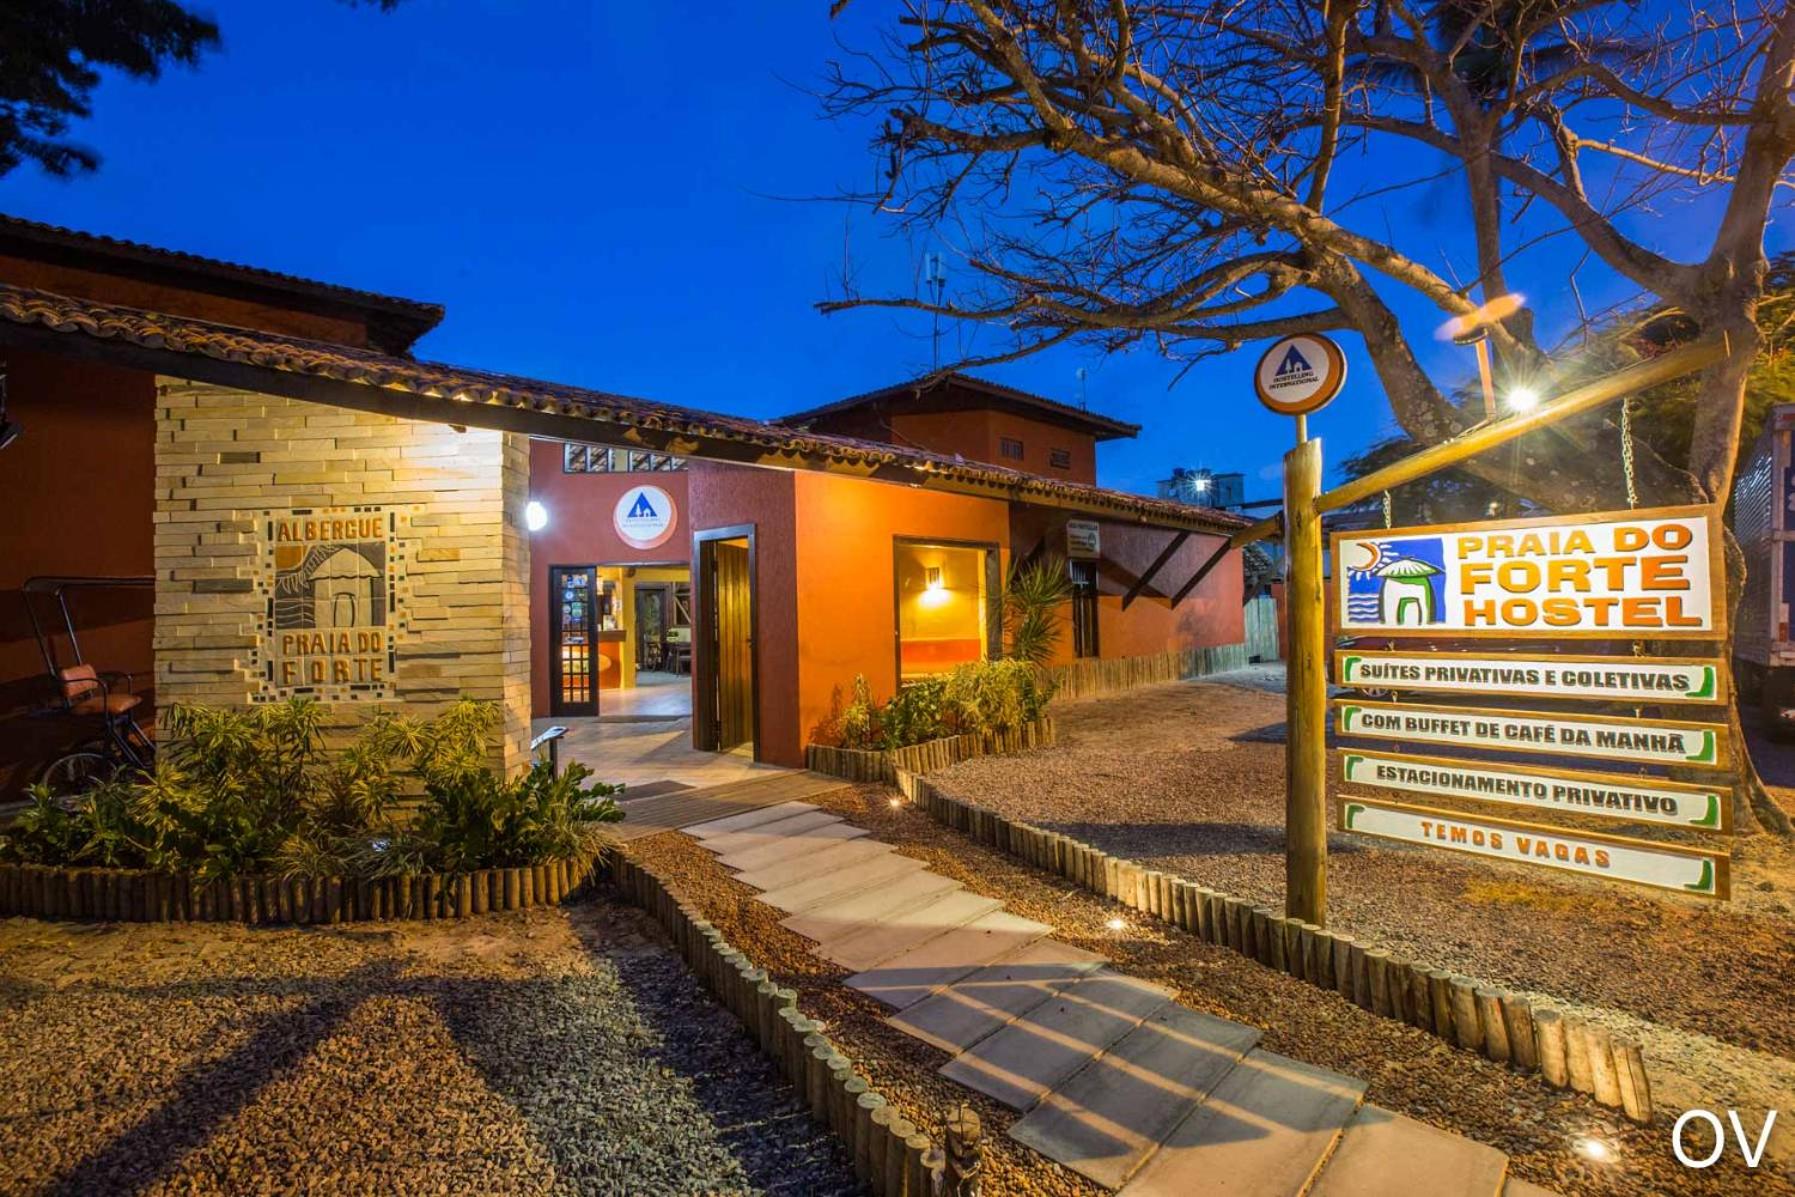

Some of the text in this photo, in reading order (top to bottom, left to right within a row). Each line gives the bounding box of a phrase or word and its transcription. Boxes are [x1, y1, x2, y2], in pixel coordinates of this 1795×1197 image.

[278, 517, 383, 541] ALBERGUE
[1457, 524, 1693, 559] PRAIA DO
[1460, 555, 1691, 595] FORTE
[1464, 597, 1703, 627] HOSTEL
[282, 630, 382, 655] PRAIA DO
[281, 658, 383, 684] FORTE
[1360, 663, 1690, 691] SUÍTES PRIVATIVAS E COLETIVAS
[1362, 713, 1687, 754] COM BUFFET DE CAFÉ DA MANHÃ
[1376, 764, 1679, 816] ESTACIONAMENTO PRIVATIVO
[1421, 821, 1610, 869] TEMOS VAGAS
